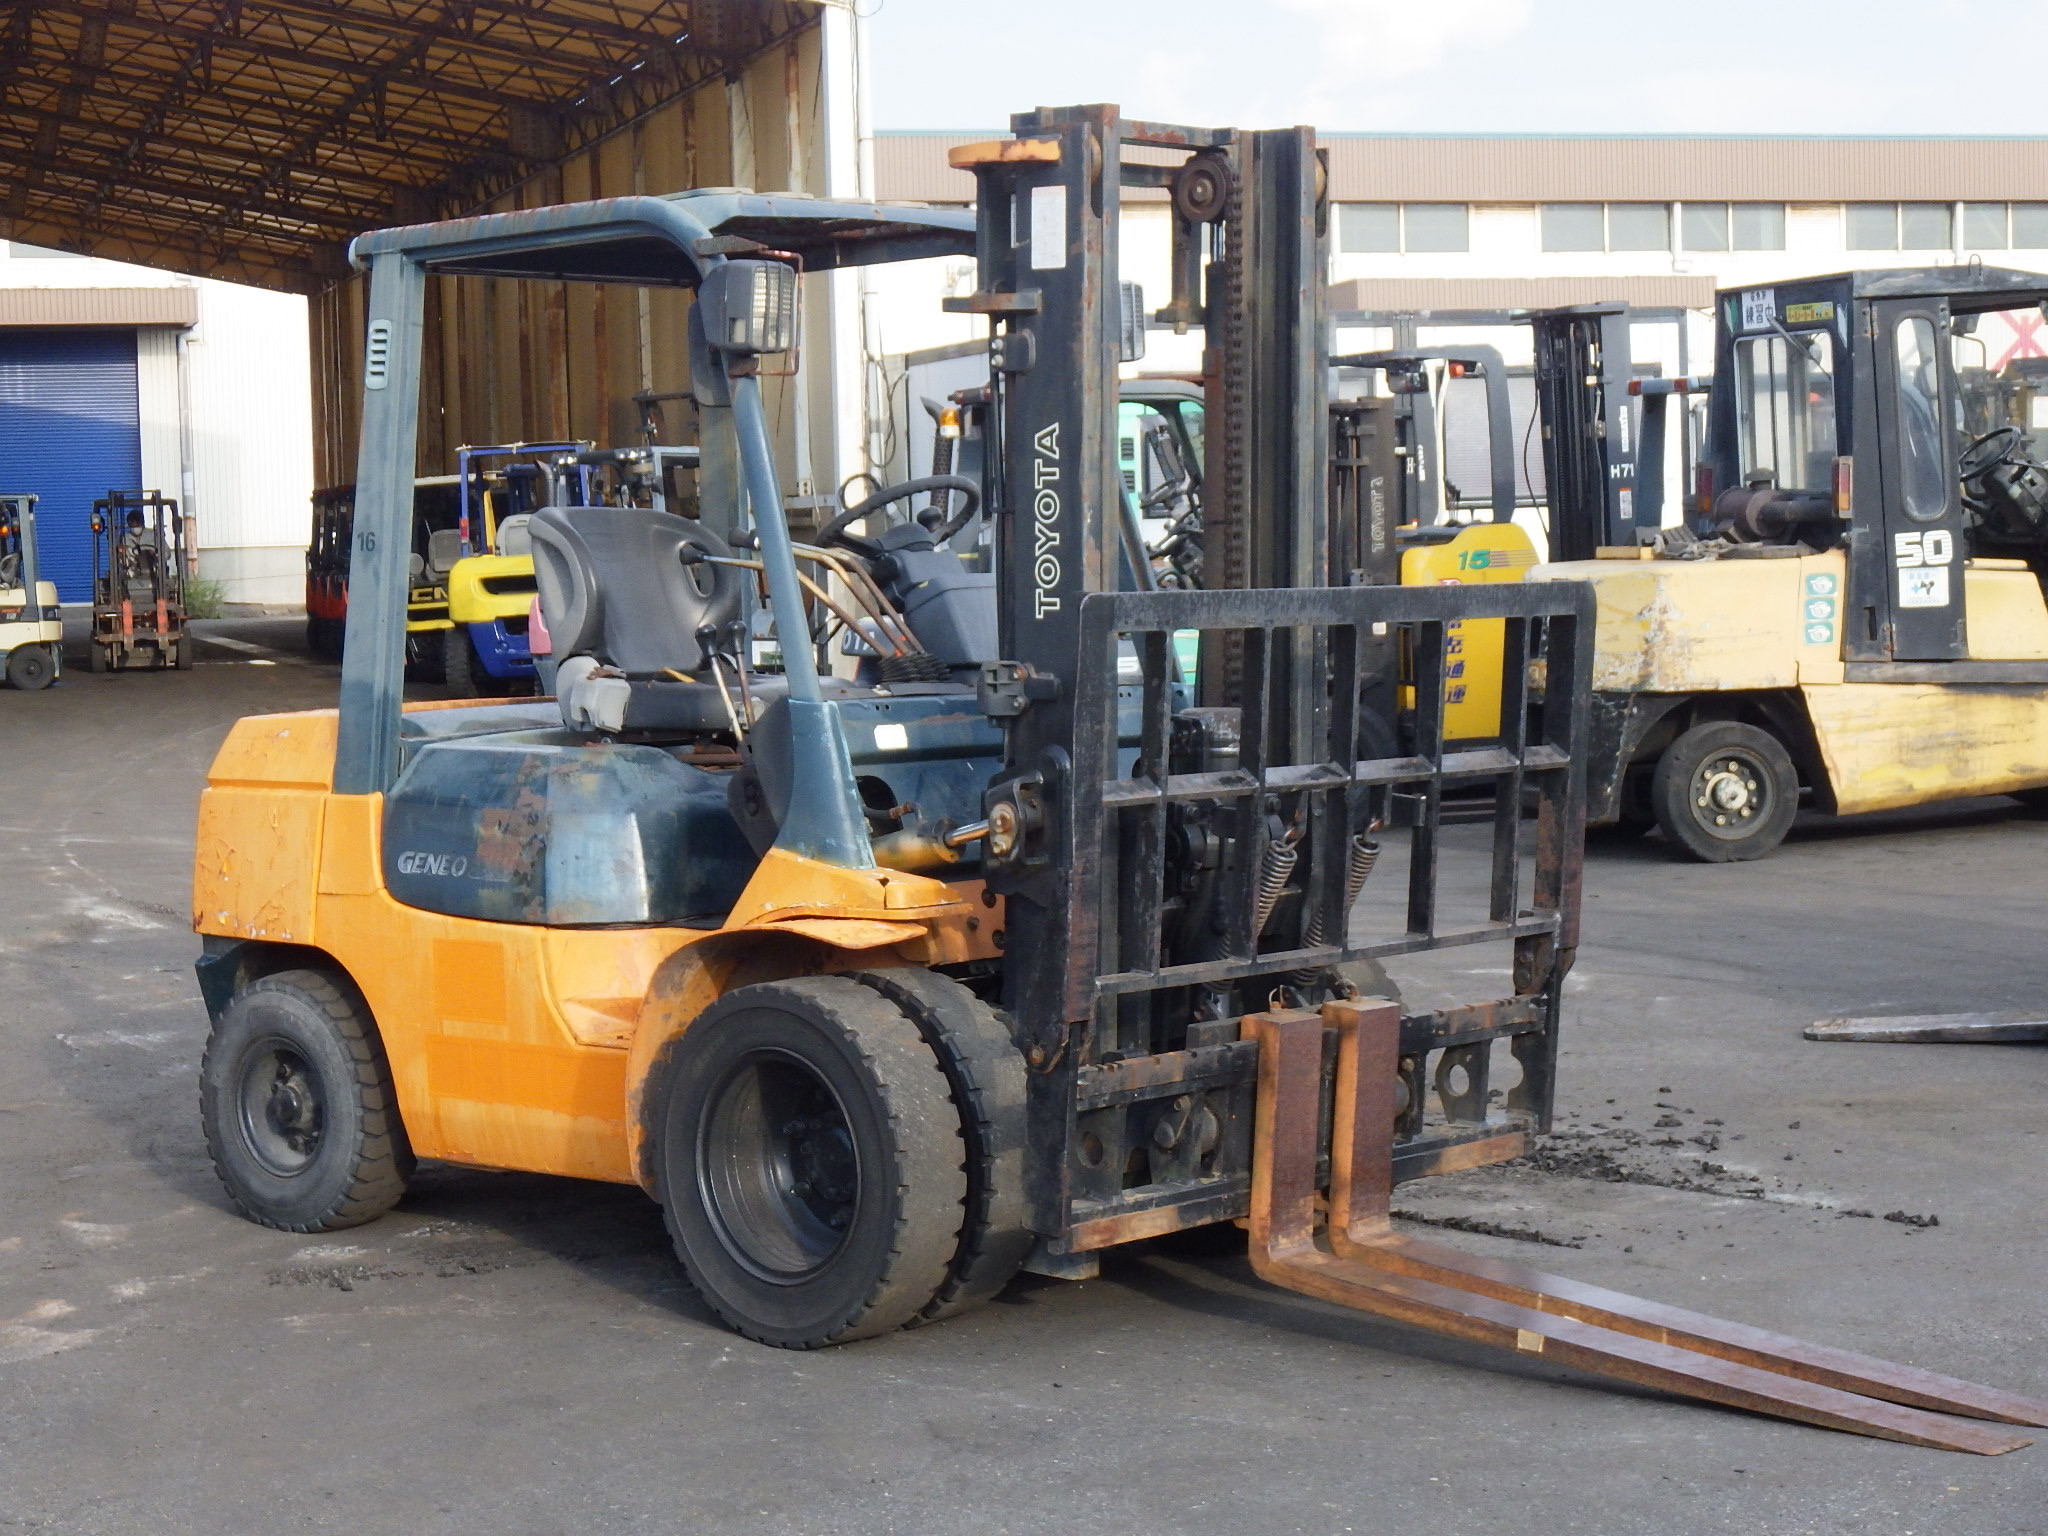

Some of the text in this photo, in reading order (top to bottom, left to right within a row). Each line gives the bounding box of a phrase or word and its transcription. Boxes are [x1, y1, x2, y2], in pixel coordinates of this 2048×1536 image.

[1611, 463, 1634, 478] H71
[1035, 422, 1060, 619] TOYOTA
[1371, 477, 1385, 552] TOYOTA
[357, 531, 376, 552] 16
[1895, 530, 1953, 568] 50
[1459, 550, 1490, 570] 15
[398, 851, 468, 877] GENEO
